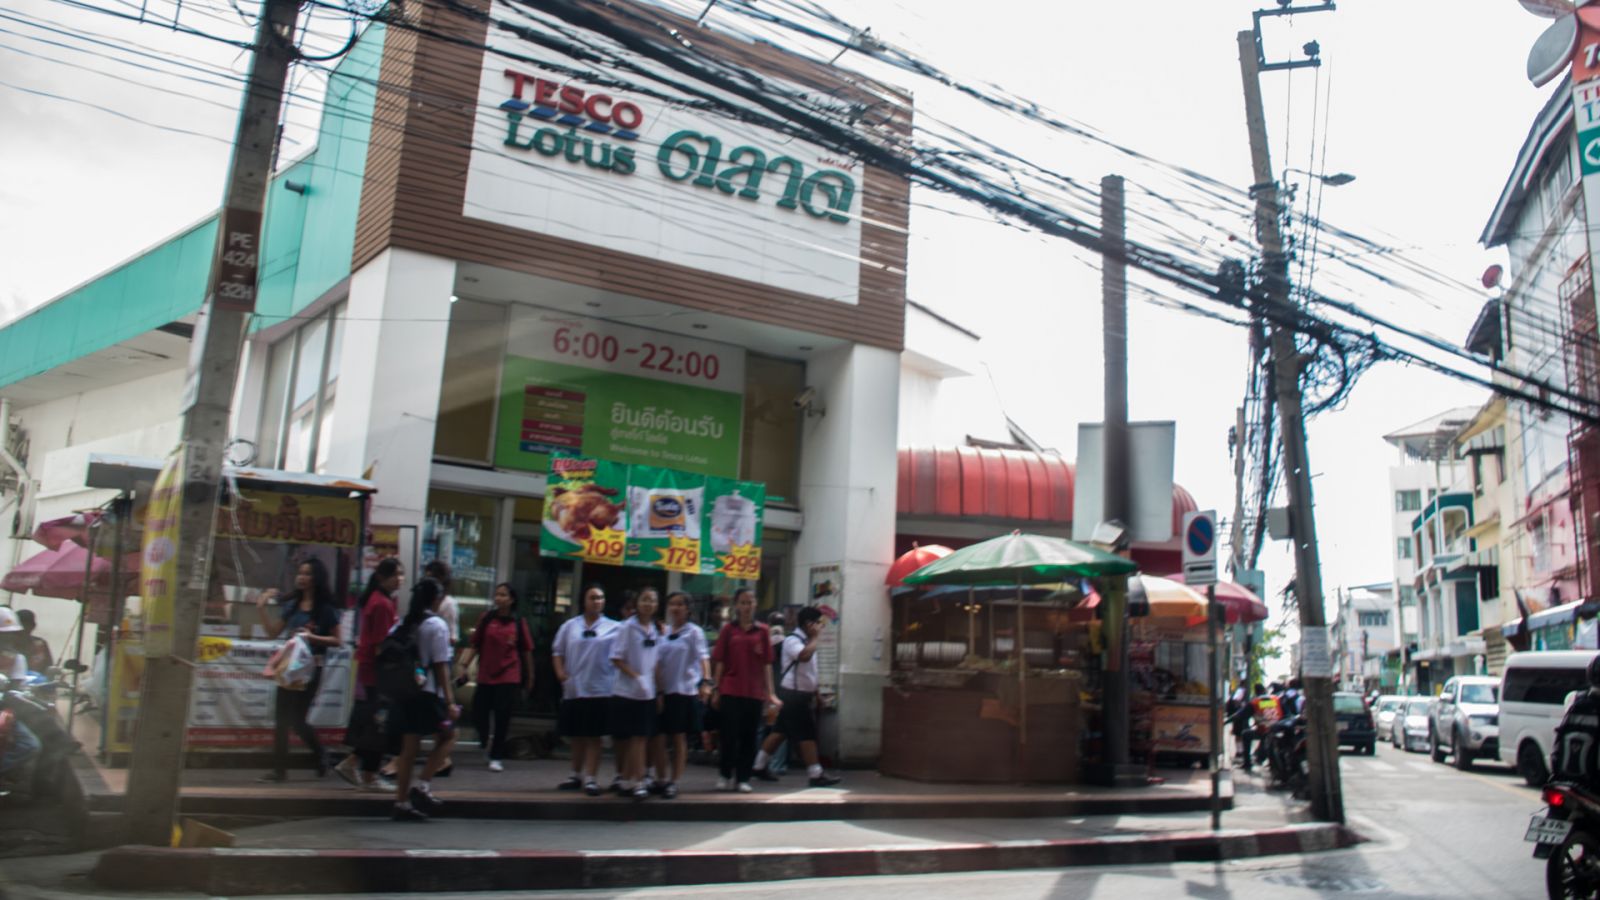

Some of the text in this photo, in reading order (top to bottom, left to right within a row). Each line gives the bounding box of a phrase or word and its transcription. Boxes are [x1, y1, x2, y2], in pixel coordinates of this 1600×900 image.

[504, 69, 643, 129] TESCO
[504, 112, 636, 175] Lotus
[657, 129, 856, 224] ตลาด
[229, 231, 254, 249] PE
[610, 402, 725, 439] ยินดีต้อนรับ
[585, 538, 624, 558] 109
[667, 547, 698, 567] 179
[723, 554, 760, 575] 299
